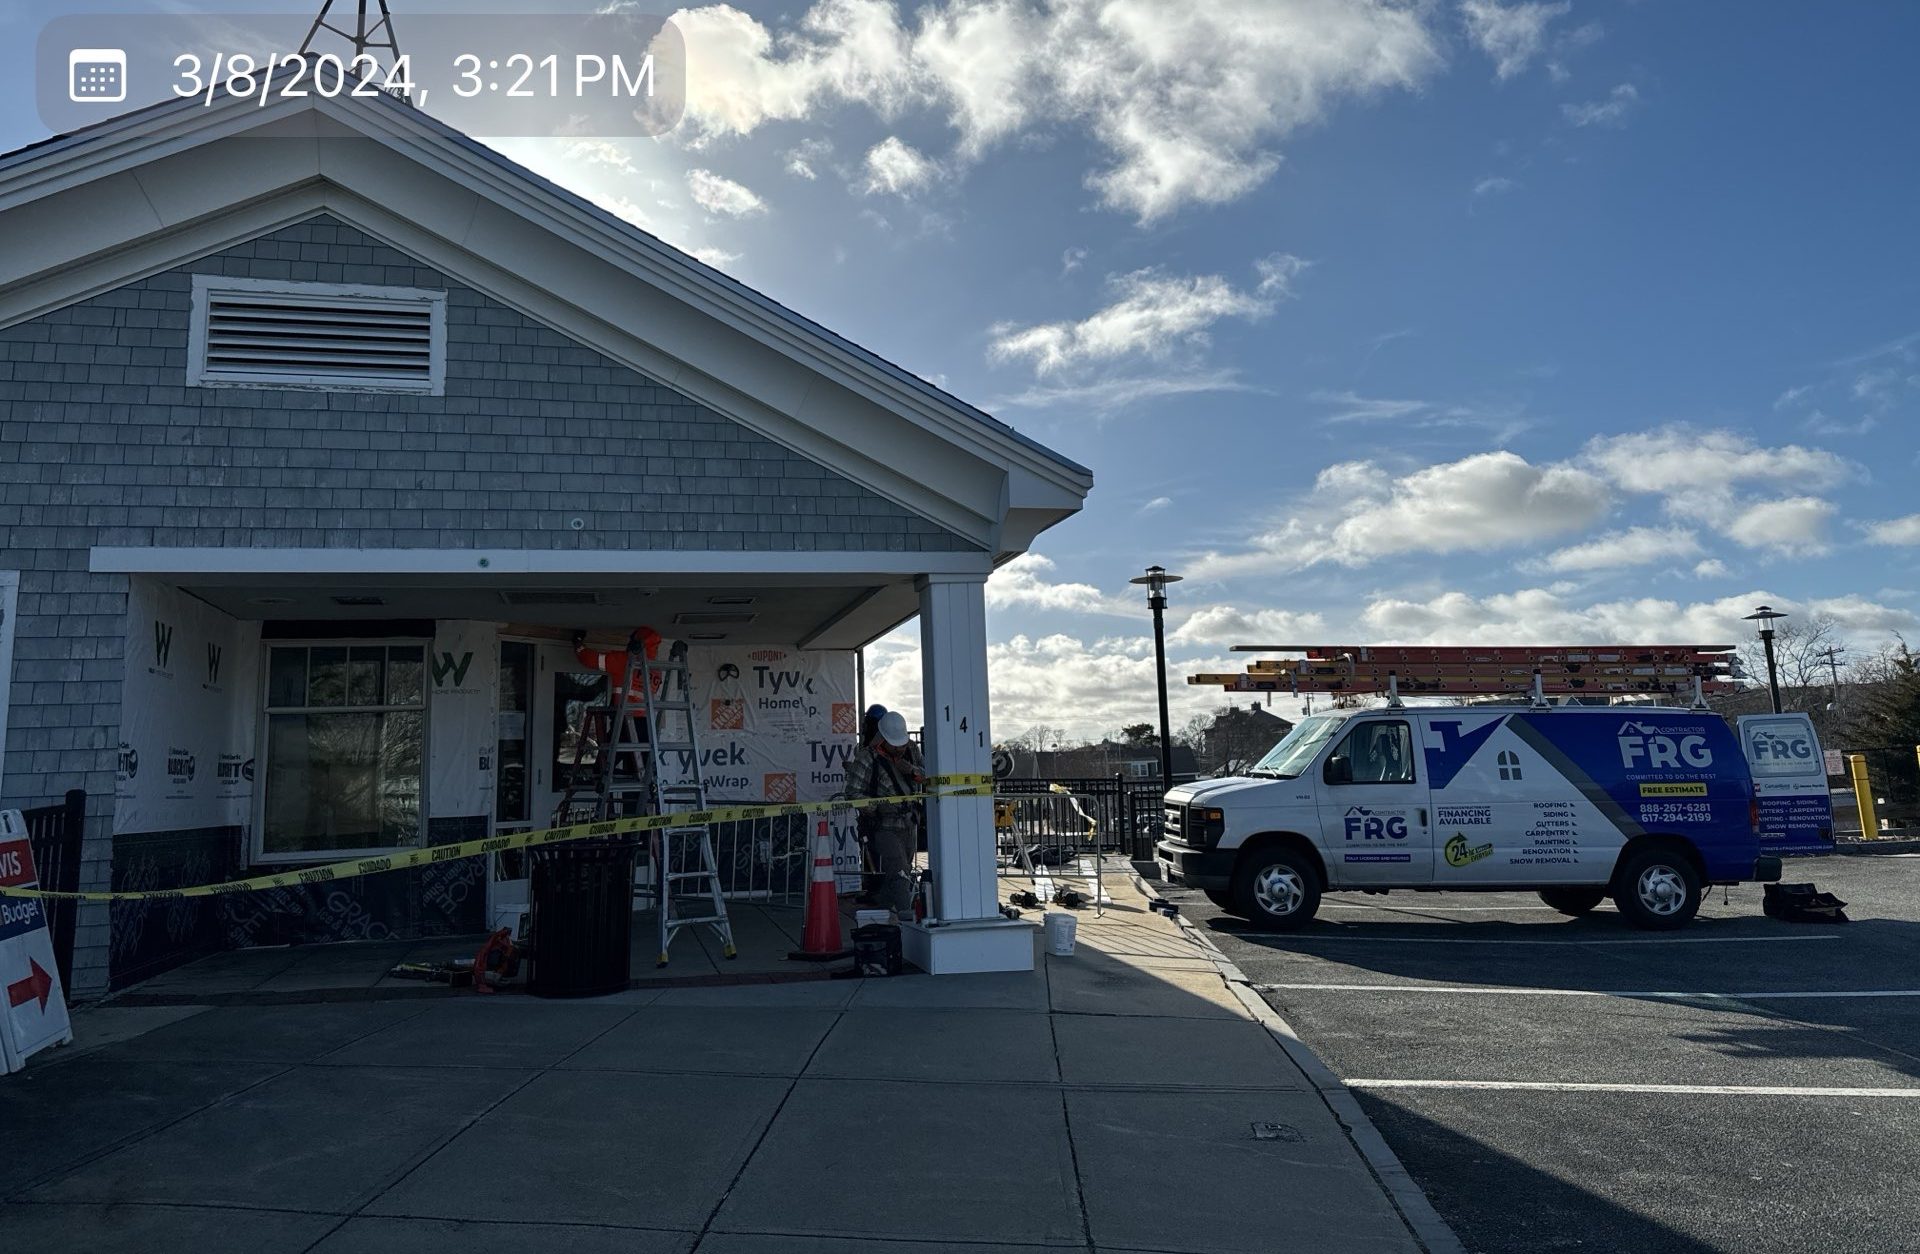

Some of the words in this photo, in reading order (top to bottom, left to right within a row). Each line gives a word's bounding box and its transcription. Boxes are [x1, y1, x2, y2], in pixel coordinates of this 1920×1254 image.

[751, 650, 785, 662] DUPONT
[753, 666, 815, 695] Tyvk
[806, 741, 852, 768] Tyv
[1618, 735, 1713, 769] FRG
[1752, 739, 1811, 760] FRG
[1665, 786, 1704, 794] ESTIMATE
[742, 808, 765, 819] CAUTION
[1438, 810, 1491, 818] FINANCING
[1640, 803, 1711, 813] 888-267-6281
[648, 816, 672, 828] CAUTION
[688, 812, 713, 823] CUIDADO
[1439, 817, 1492, 825] AVAILABLE
[1536, 820, 1569, 828] GUTTERS
[1641, 813, 1712, 823] 617-294-2199
[544, 828, 571, 841] CAUTION
[1344, 817, 1408, 840] FRG
[481, 838, 511, 852] CUIDADO
[1452, 842, 1468, 862] 24
[432, 846, 461, 861] CAUTION
[0, 850, 22, 879] VIS
[298, 867, 334, 883] CAUTION
[435, 853, 486, 915] RACE
[1, 898, 39, 925] Budget
